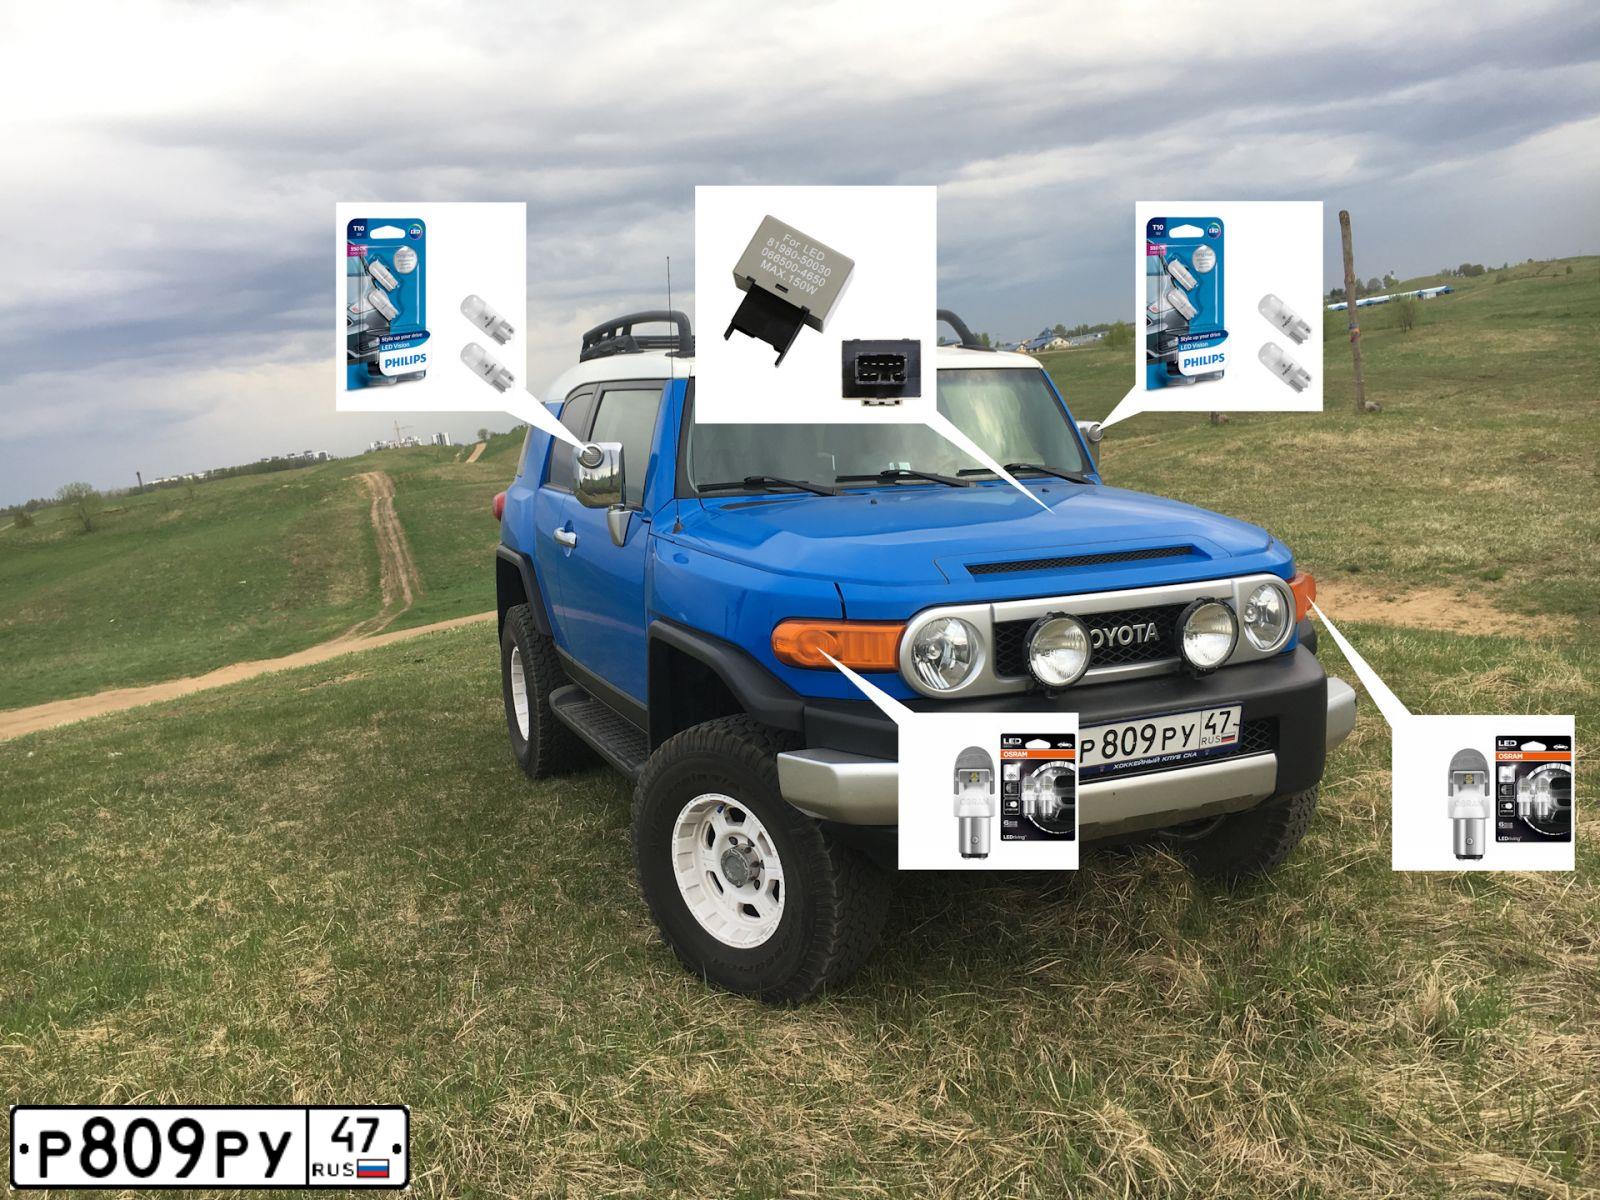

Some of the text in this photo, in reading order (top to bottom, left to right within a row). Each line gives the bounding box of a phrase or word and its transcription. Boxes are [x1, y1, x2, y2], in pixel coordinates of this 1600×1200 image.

[1091, 623, 1160, 649] OYOTA
[1204, 710, 1231, 735] 47
[1201, 735, 1221, 745] RUS
[1113, 751, 1198, 770] ХОККЕЙНЫЙ КЛУБ СКА
